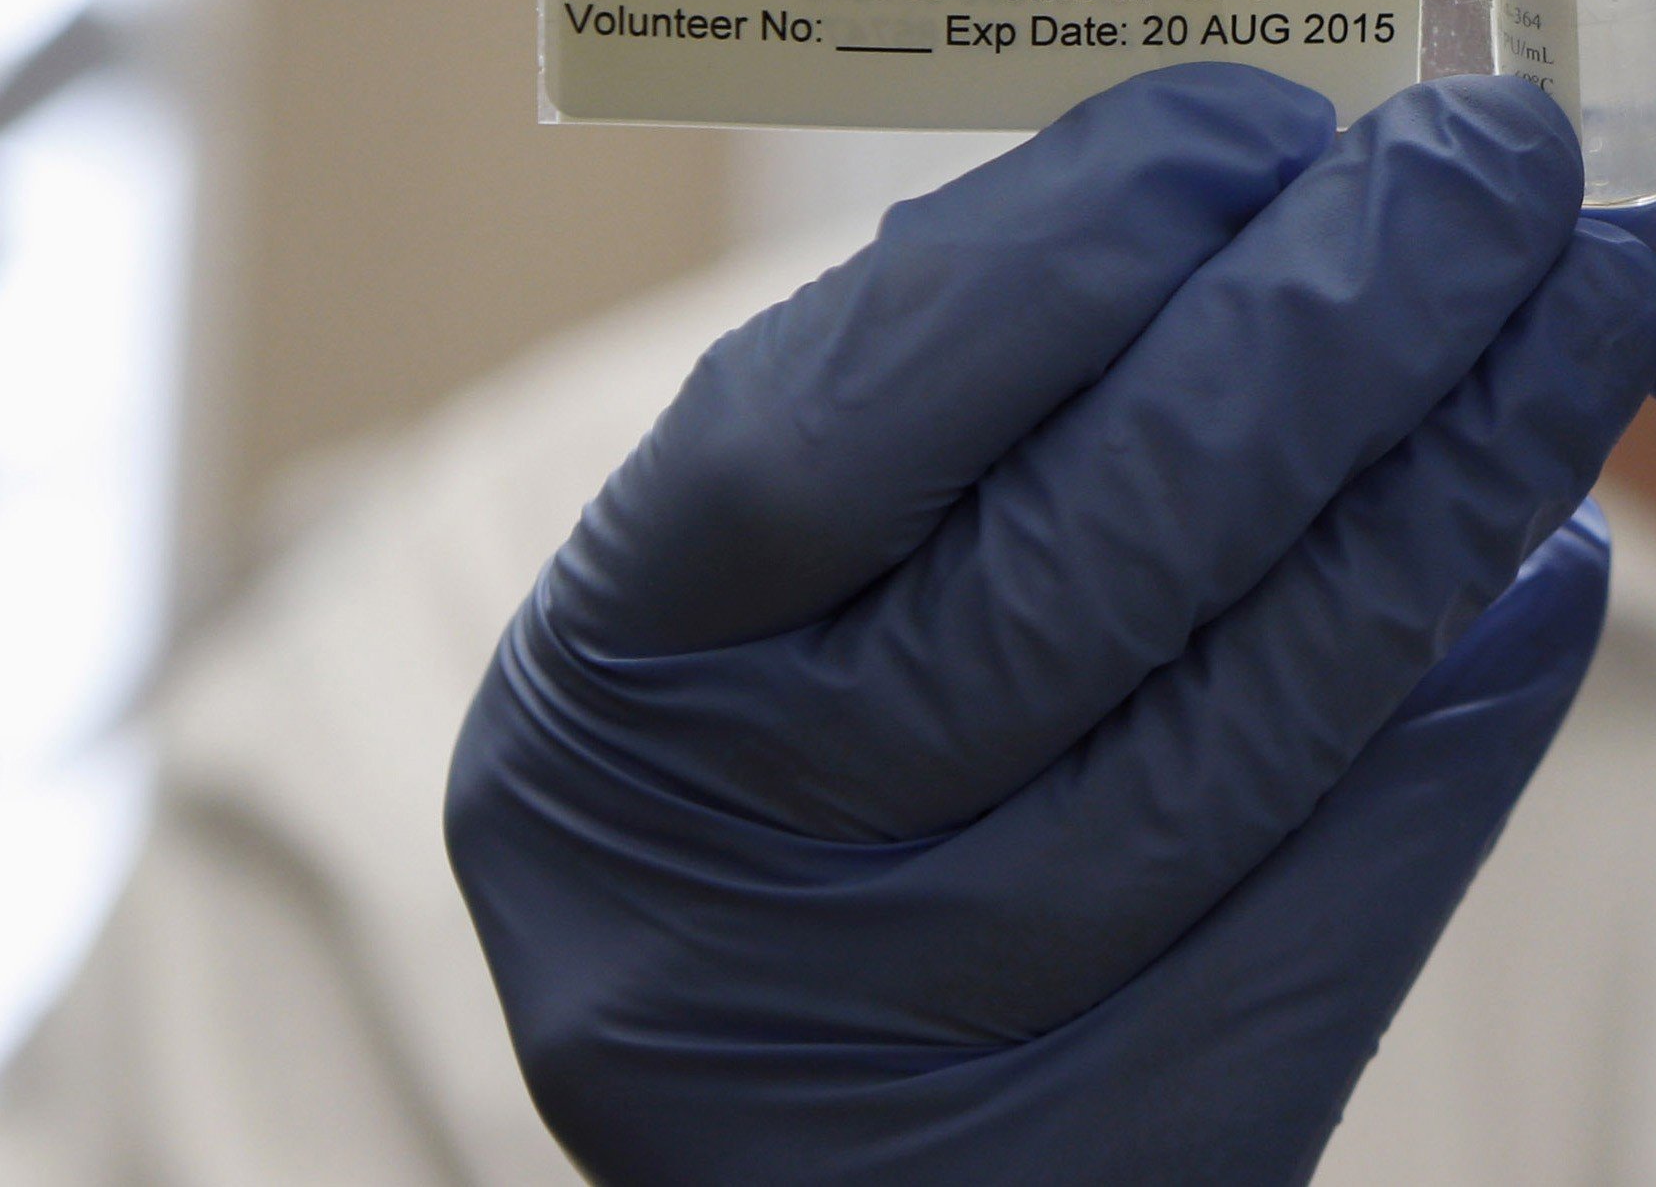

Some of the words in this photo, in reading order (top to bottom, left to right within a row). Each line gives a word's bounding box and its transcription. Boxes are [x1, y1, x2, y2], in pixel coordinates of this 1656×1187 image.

[563, 2, 749, 41] Volunteer
[760, 9, 823, 43] No:
[946, 14, 1017, 55] Exp
[1030, 15, 1128, 47] Date:
[1141, 14, 1189, 47] 20
[1199, 12, 1291, 46] AUG
[1303, 12, 1396, 45] 2015
